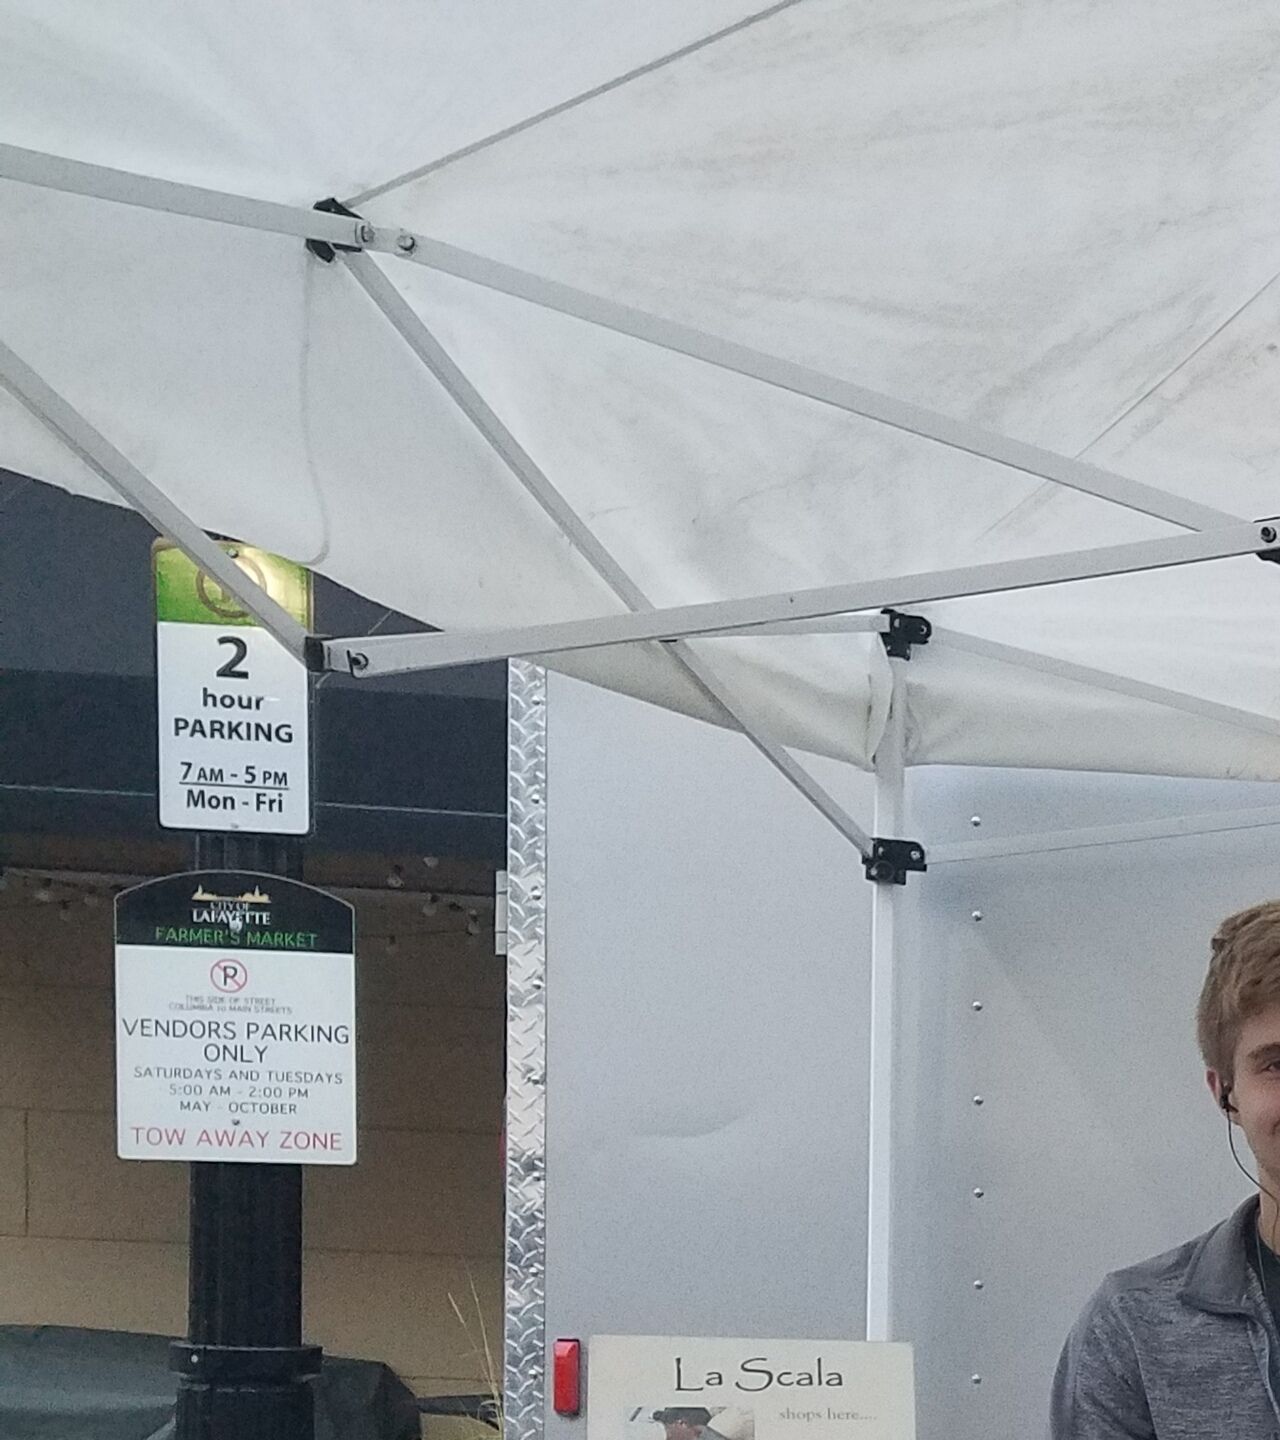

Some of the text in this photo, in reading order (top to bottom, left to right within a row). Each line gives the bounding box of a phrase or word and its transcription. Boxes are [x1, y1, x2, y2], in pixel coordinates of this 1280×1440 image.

[216, 636, 249, 679] 2
[202, 688, 264, 710] hour
[173, 717, 294, 743] PARKING
[179, 762, 192, 781] 7
[197, 768, 224, 783] AM
[244, 765, 256, 784] 5
[262, 771, 288, 786] PM
[186, 789, 236, 812] Mon
[255, 793, 283, 813] Fri
[155, 926, 318, 948] FARMER'S MARKET
[122, 1018, 349, 1044] VENDORS PARKING
[204, 1043, 268, 1063] ONLY
[134, 1066, 343, 1084] SATURDAYS AND TUESDAYS
[170, 1084, 202, 1096] 5:00
[209, 1086, 231, 1097] AM
[249, 1087, 282, 1098] 2:00
[288, 1087, 309, 1099] PM
[180, 1101, 211, 1113] MAY
[228, 1102, 297, 1115] OCTOBER
[131, 1127, 342, 1151] TOW AWAY ZONE
[674, 1357, 843, 1392] La Scala
[779, 1407, 822, 1422] shops
